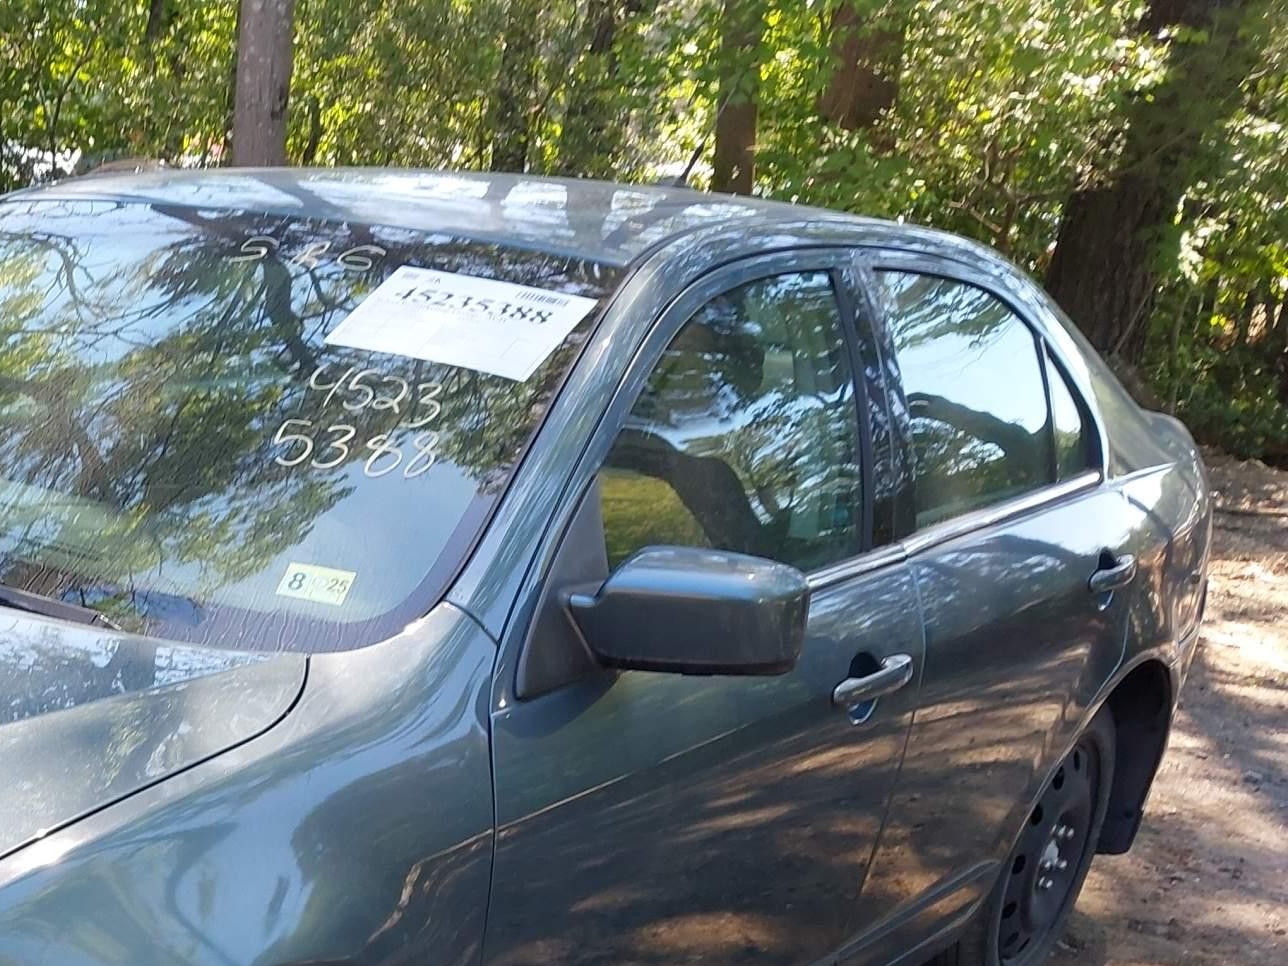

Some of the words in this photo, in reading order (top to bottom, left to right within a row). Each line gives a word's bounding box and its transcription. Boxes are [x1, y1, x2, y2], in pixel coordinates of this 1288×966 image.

[309, 363, 443, 428] 4523
[274, 419, 442, 478] 5388
[286, 572, 306, 590] 8
[326, 577, 349, 594] 25
